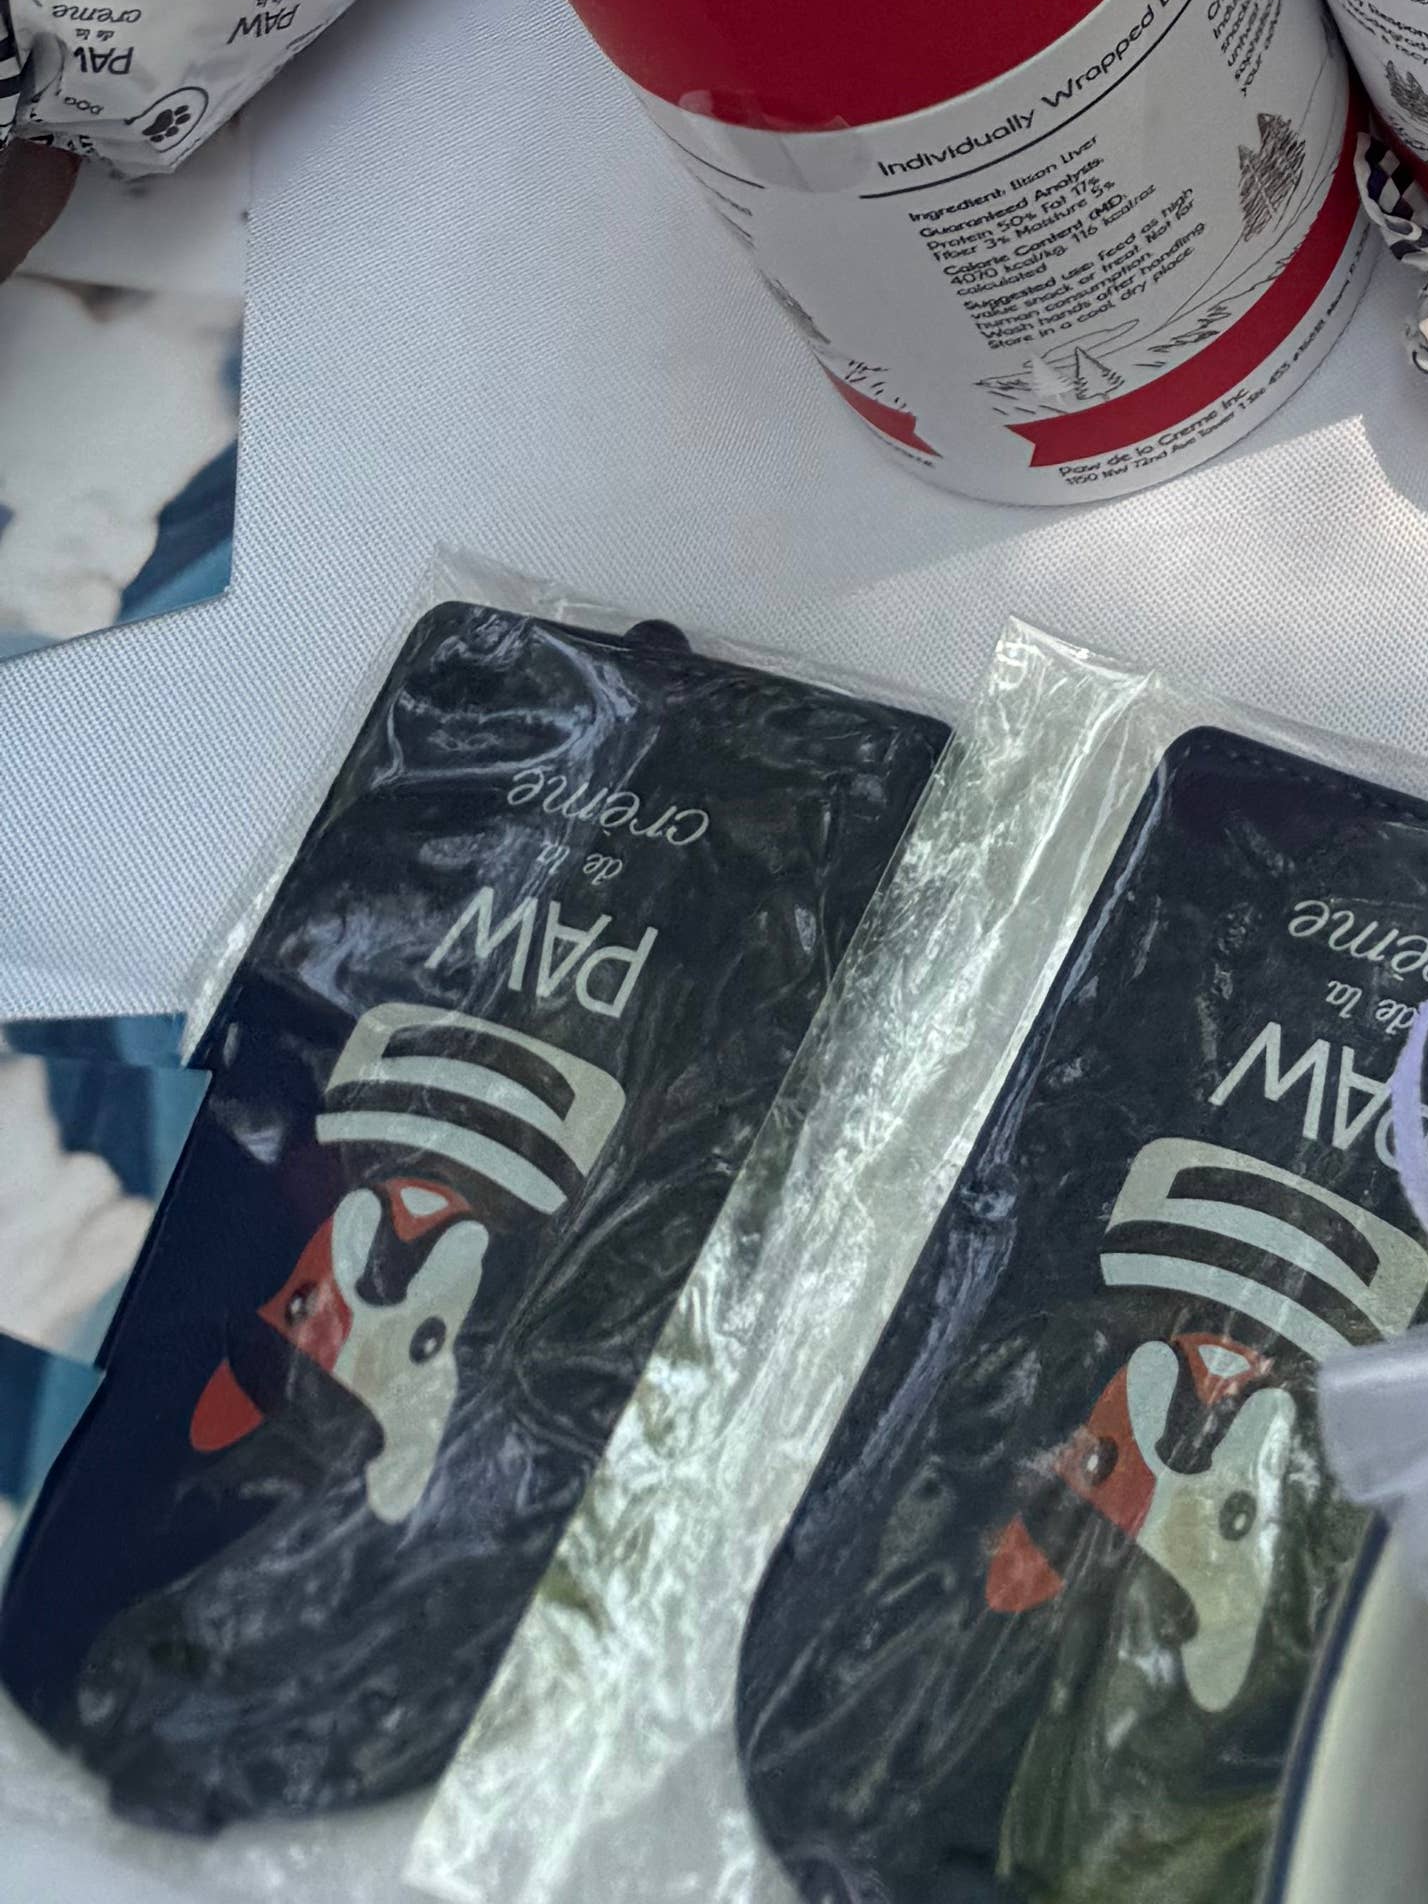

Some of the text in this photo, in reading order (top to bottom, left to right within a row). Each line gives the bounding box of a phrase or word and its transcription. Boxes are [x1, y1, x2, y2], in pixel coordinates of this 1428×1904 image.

[51, 4, 142, 24] creme
[227, 3, 301, 45] PAW
[877, 109, 1035, 177] Individually
[1041, 3, 1155, 108] Wrapped
[919, 197, 1029, 238] Guaranteed
[583, 852, 623, 886] de
[424, 886, 658, 1018] PAW
[1326, 979, 1418, 1034] de la
